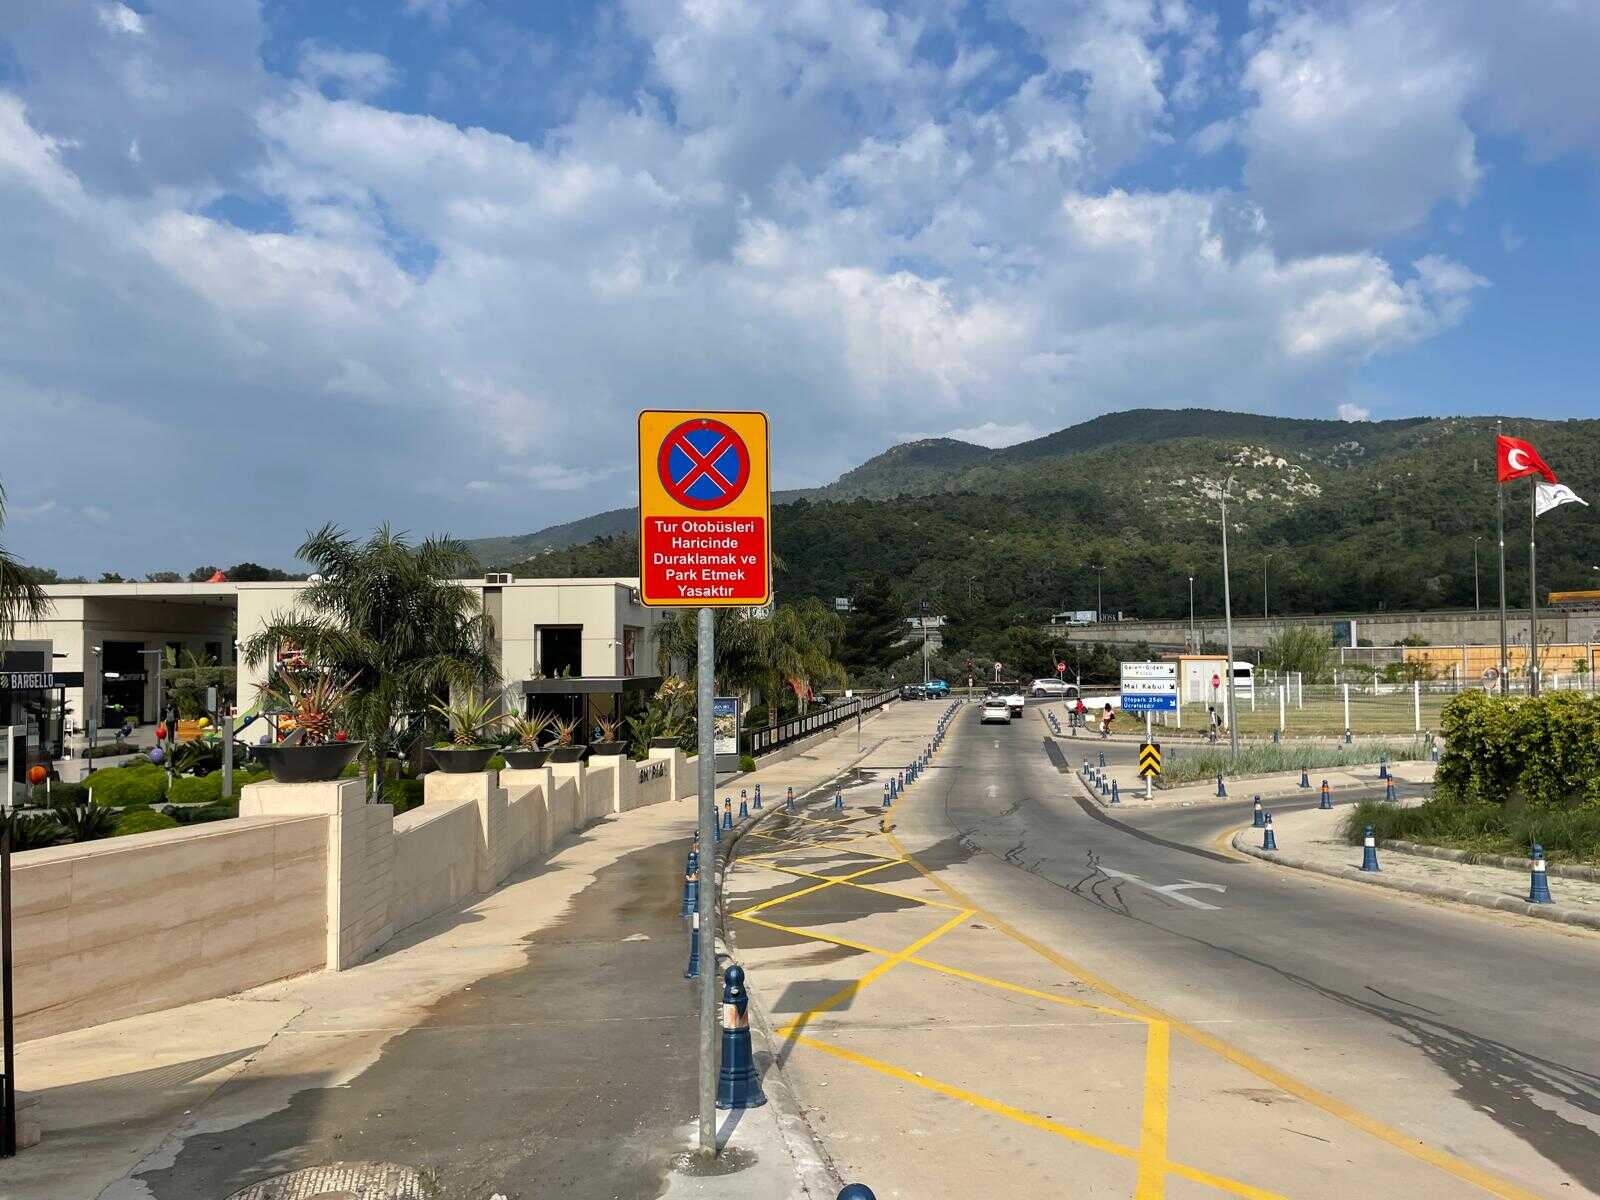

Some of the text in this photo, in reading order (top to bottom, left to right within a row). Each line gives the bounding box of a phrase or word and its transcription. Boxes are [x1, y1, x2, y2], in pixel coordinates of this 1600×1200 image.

[655, 520, 755, 533] Tur Otobüsleri
[672, 537, 739, 549] Haricinde
[653, 553, 757, 565] Duraklamak ve
[665, 569, 745, 581] Park Etmek
[678, 585, 734, 597] Yasaktır
[11, 674, 54, 689] BARGELLO
